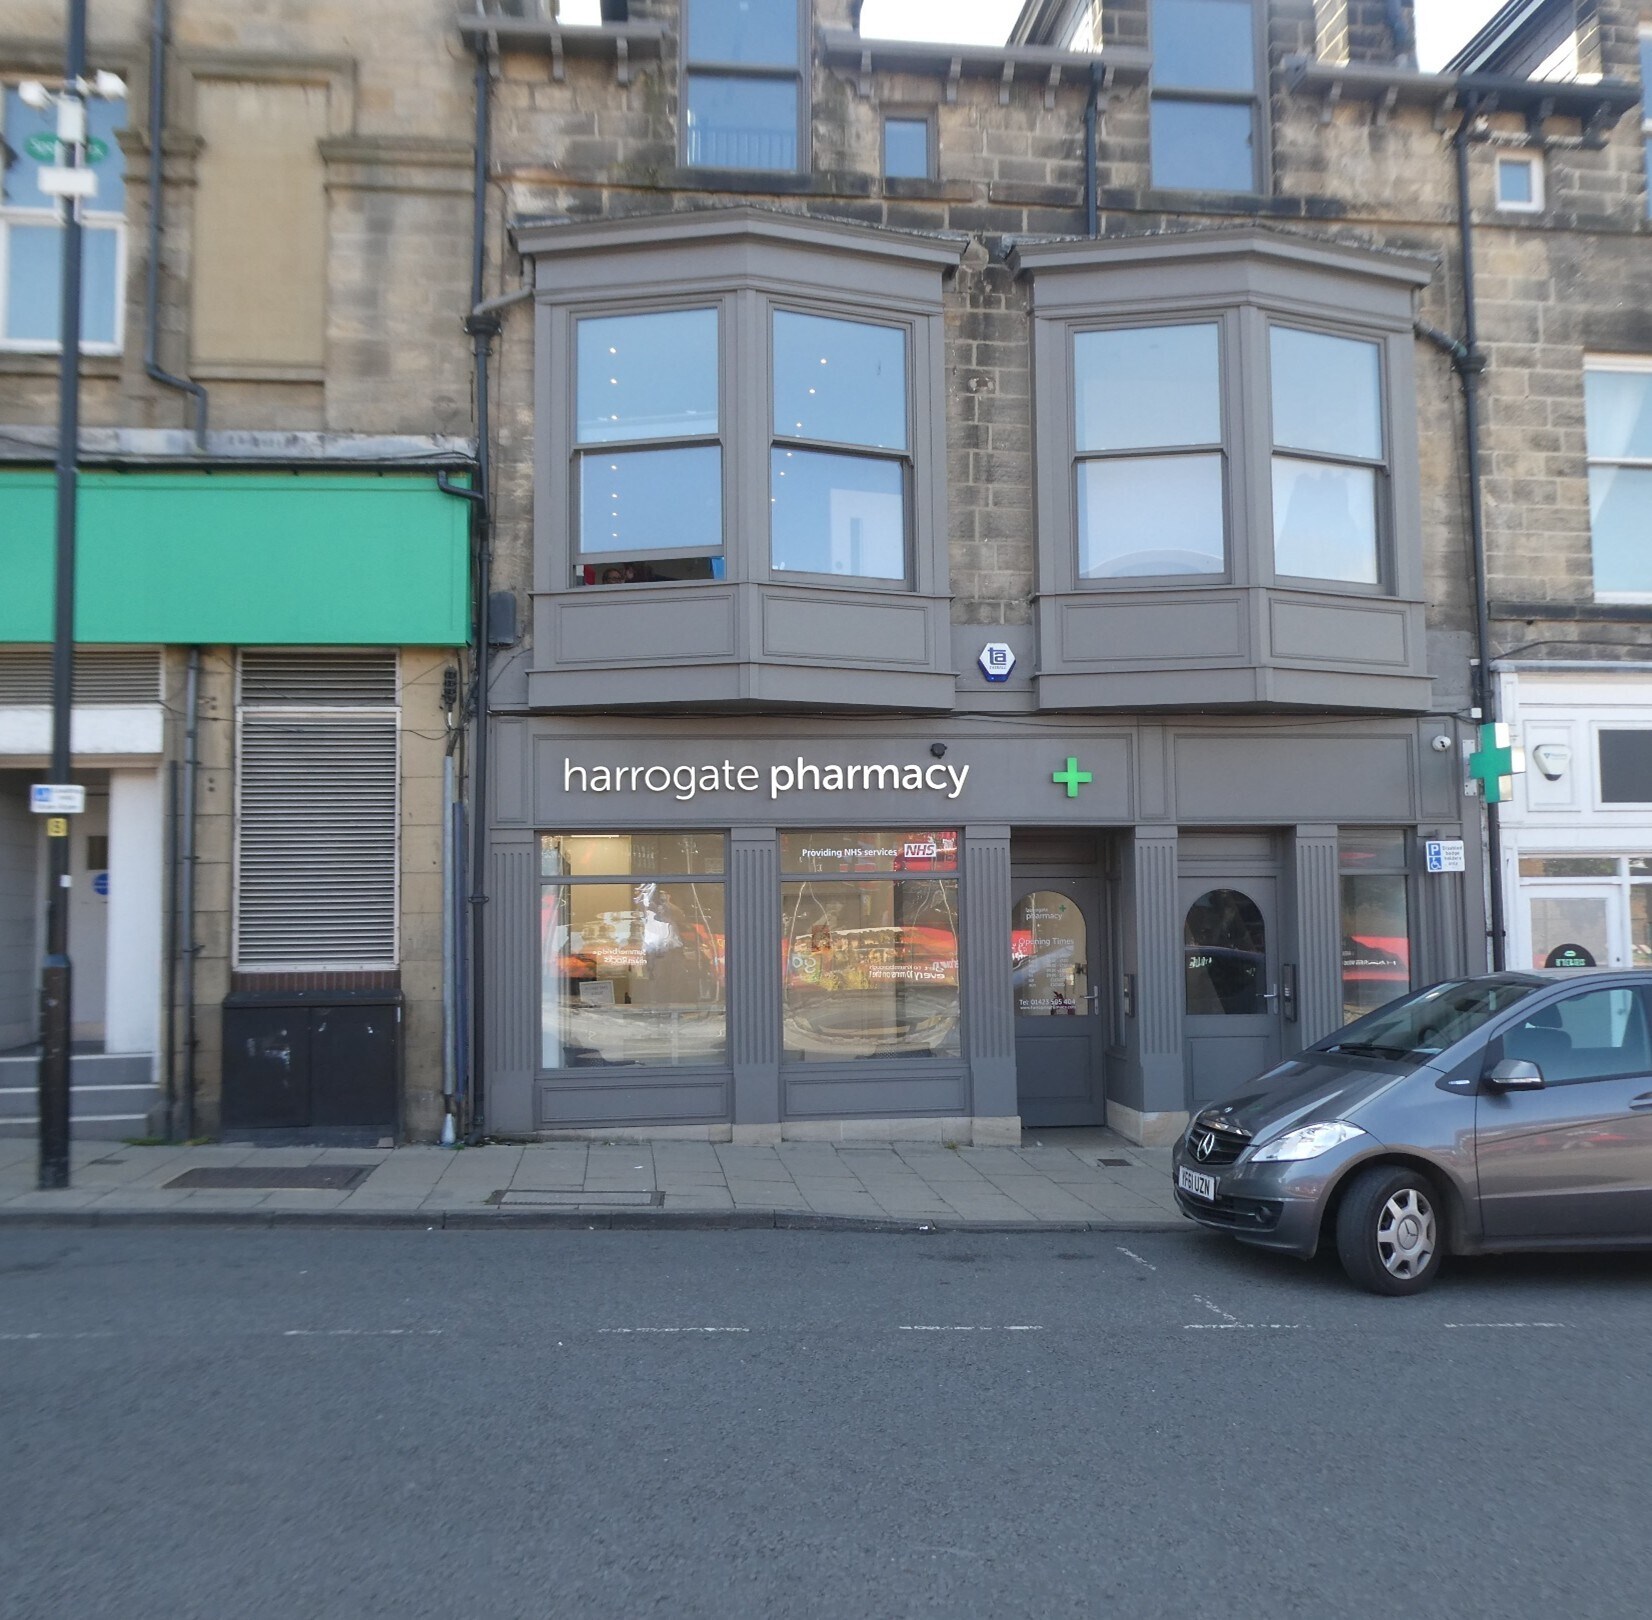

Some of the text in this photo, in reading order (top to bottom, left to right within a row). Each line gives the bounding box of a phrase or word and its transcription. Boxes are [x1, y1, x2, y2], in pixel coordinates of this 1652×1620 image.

[564, 757, 970, 801] harrogate pharmacy
[802, 849, 842, 858] Providing
[905, 844, 935, 856] NHS
[1026, 912, 1063, 920] pharmacy
[1018, 938, 1050, 947] Opening
[1194, 1175, 1211, 1196] UZN
